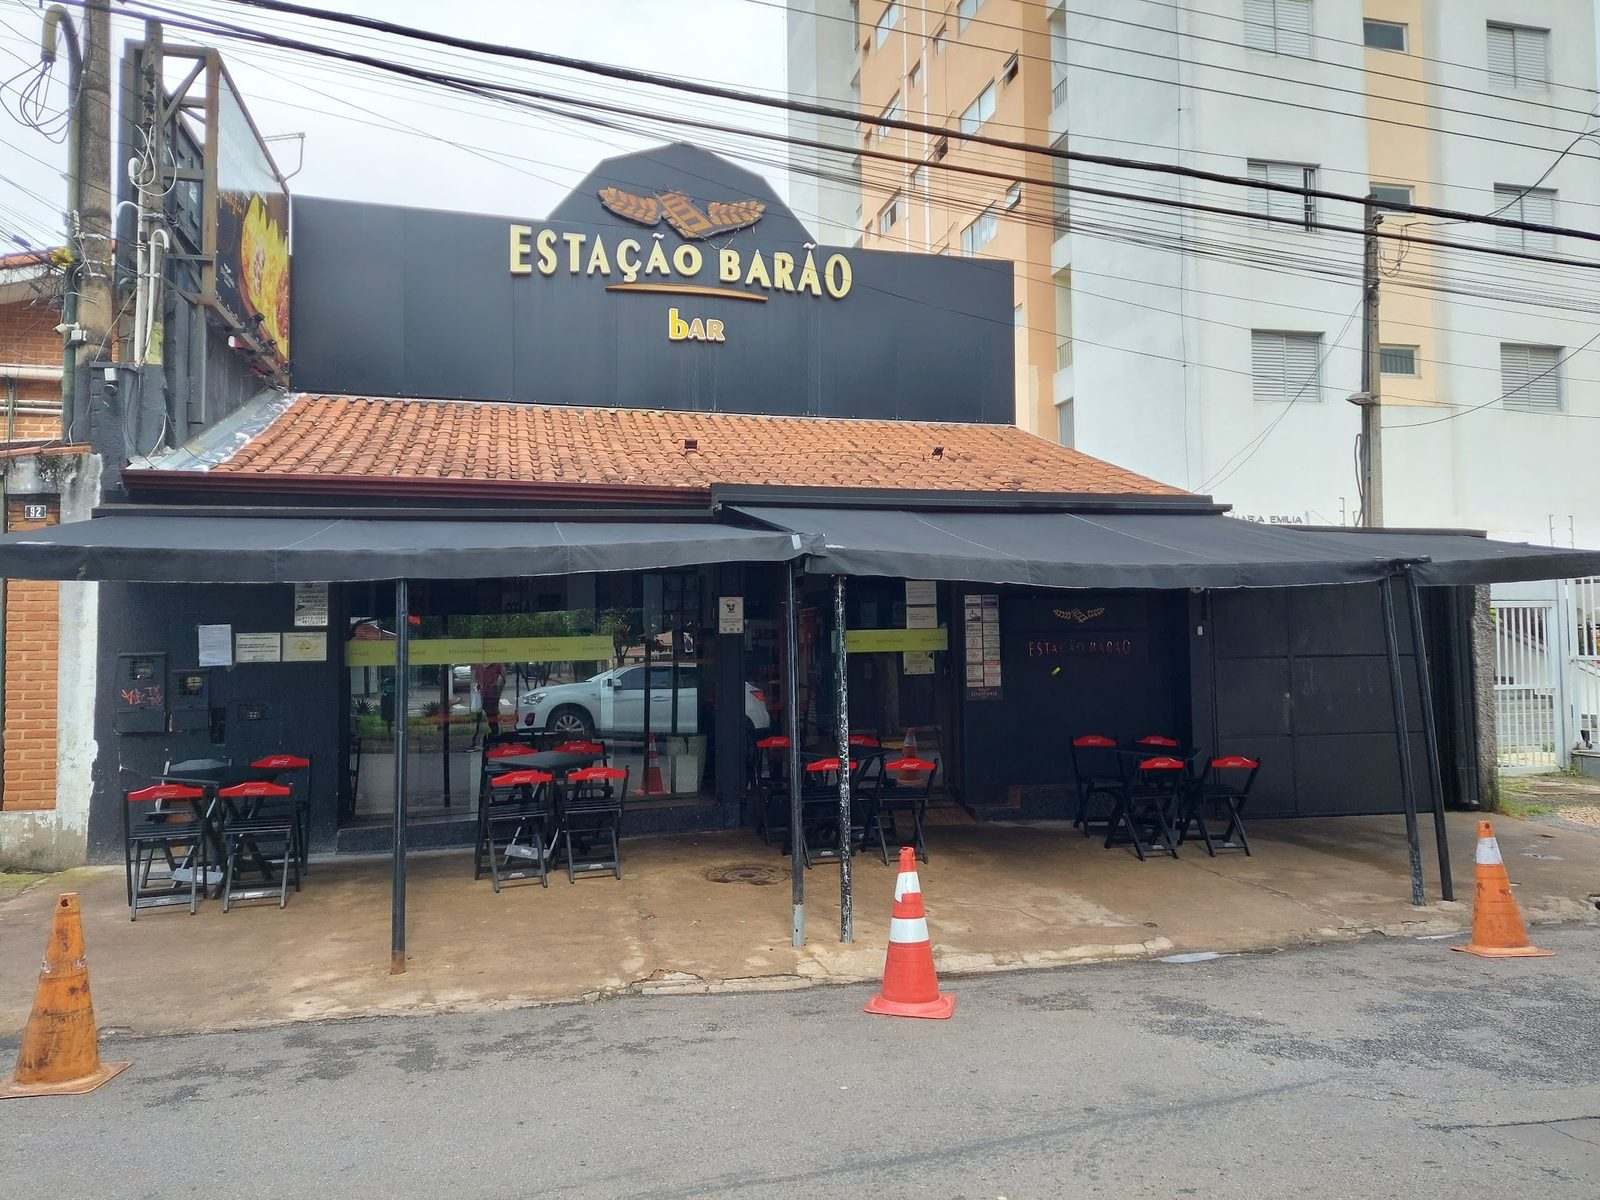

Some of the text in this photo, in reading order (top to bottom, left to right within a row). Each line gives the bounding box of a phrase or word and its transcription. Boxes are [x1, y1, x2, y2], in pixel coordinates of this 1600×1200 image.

[510, 224, 853, 298] ESTAÇÃO BARÃO
[30, 506, 42, 517] 92
[1270, 515, 1303, 524] EMILIA
